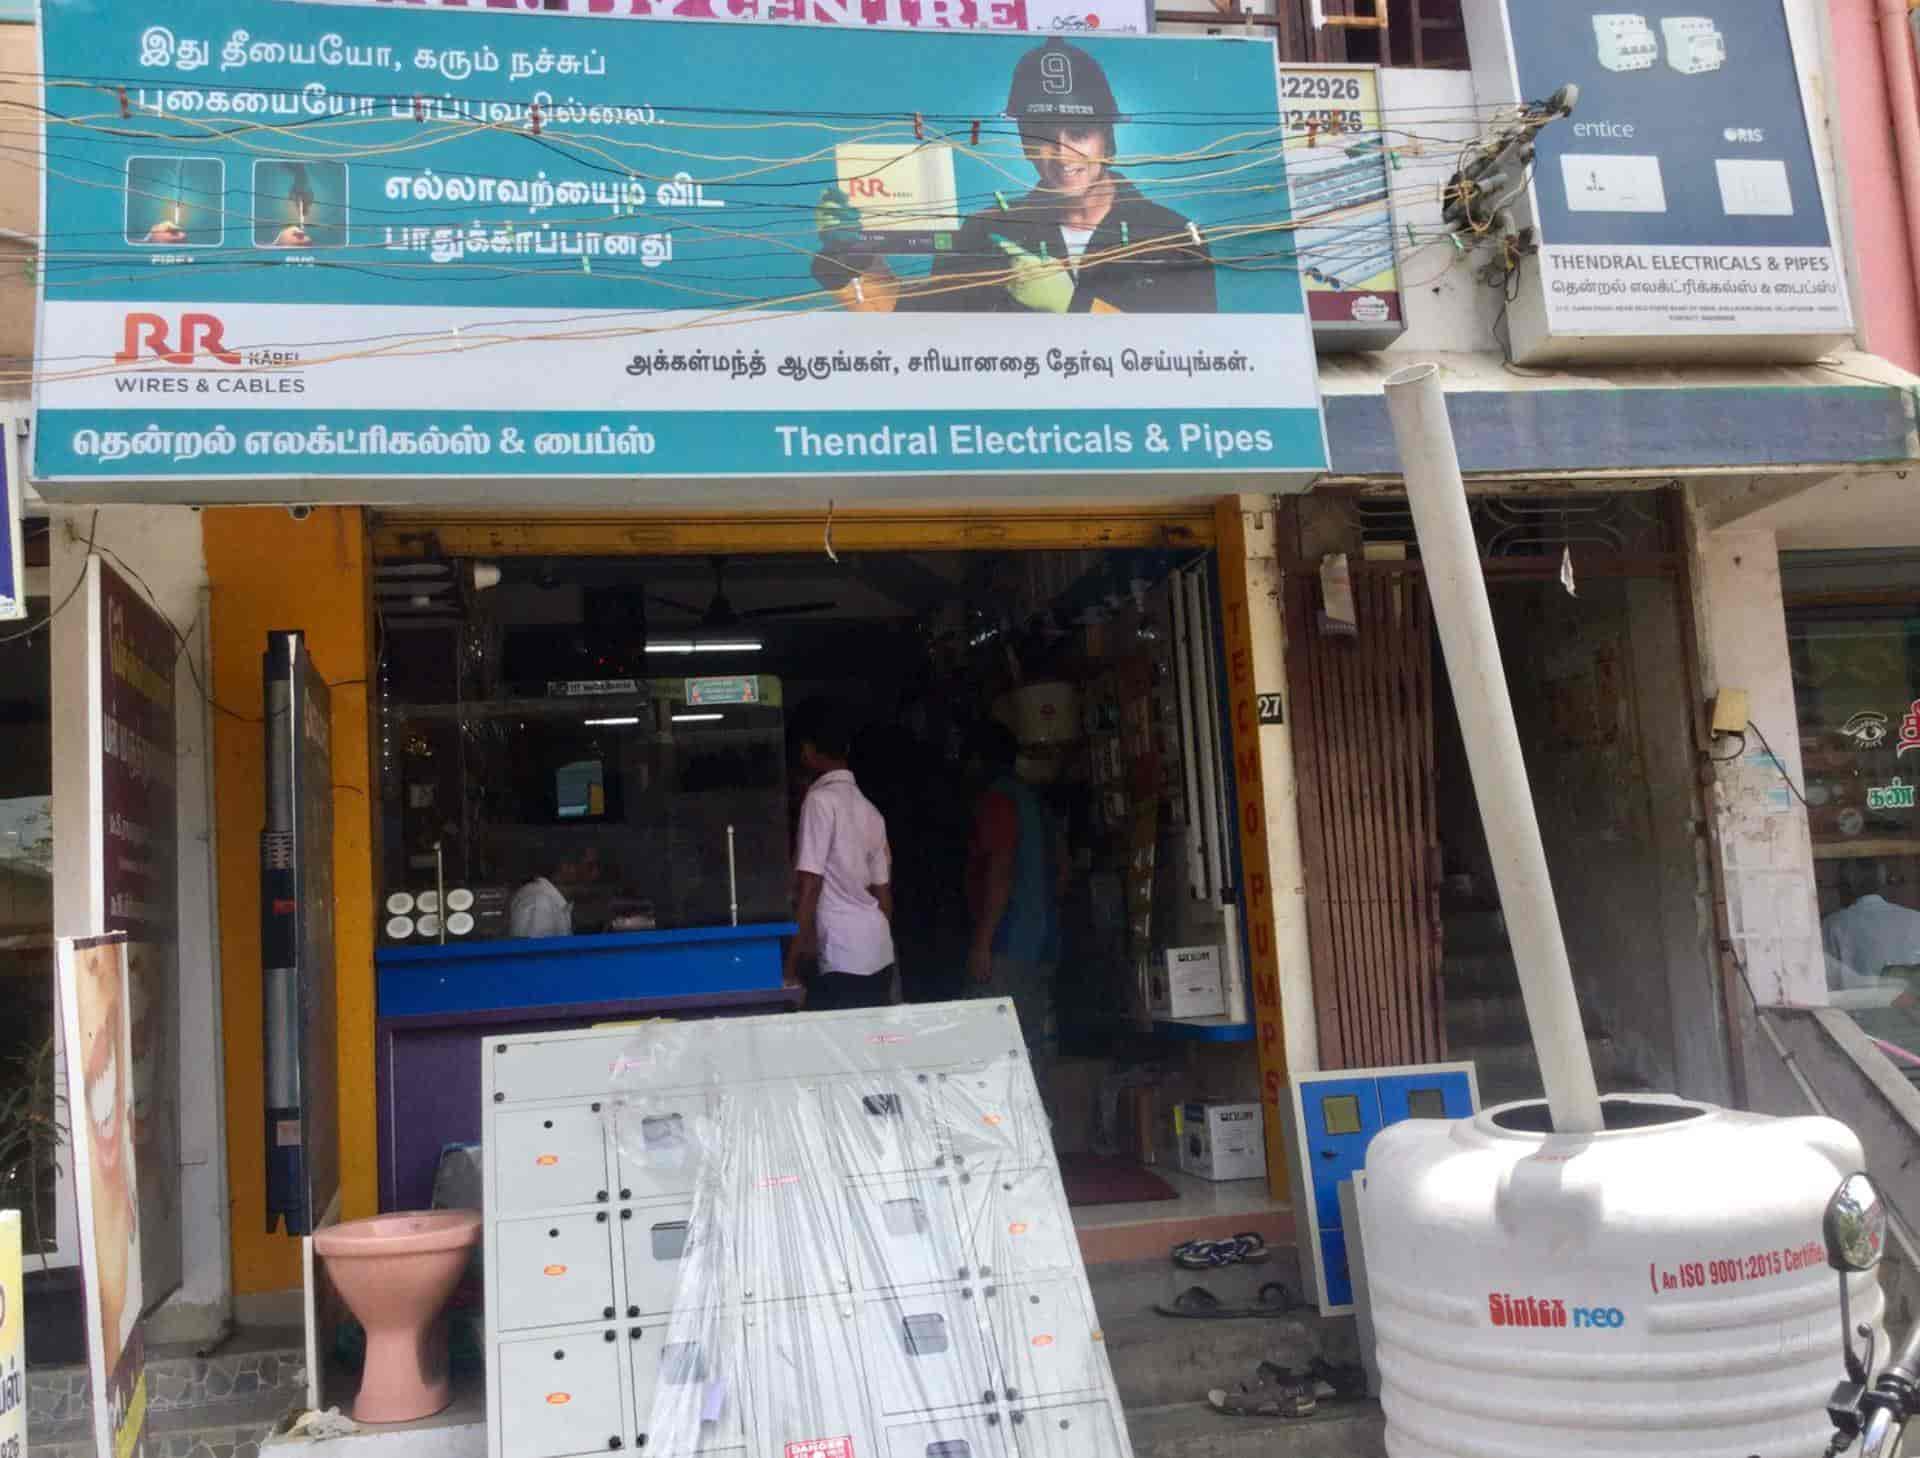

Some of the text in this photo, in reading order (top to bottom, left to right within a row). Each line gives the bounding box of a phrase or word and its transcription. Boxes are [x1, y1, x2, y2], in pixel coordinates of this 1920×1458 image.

[140, 26, 209, 70] இது
[414, 45, 499, 80] கரும்
[1040, 52, 1073, 95] 9
[1280, 77, 1360, 100] 22926
[1573, 120, 1635, 138] entice
[657, 172, 726, 208] விட
[1551, 254, 1830, 271] THENDRAL ELECTRICALS & PIPES
[1551, 278, 1626, 295] தென்றல்
[1760, 283, 1771, 294] &
[115, 312, 241, 365] RR
[907, 348, 1040, 378] சரியானதை
[1046, 348, 1114, 378] தேர்வு
[115, 378, 305, 393] WIRES & CABLES
[73, 424, 236, 463] தென்றல்
[500, 427, 525, 455] &
[534, 424, 656, 456] பைப்ஸ்
[775, 422, 1274, 458] Thendral Electricals & Pipes
[1259, 696, 1282, 718] 27
[1662, 1271, 1678, 1289] An
[1680, 1262, 1705, 1288] ISO
[1709, 1250, 1782, 1285] 9001:2015
[1489, 1293, 1625, 1329] Sintex neo
